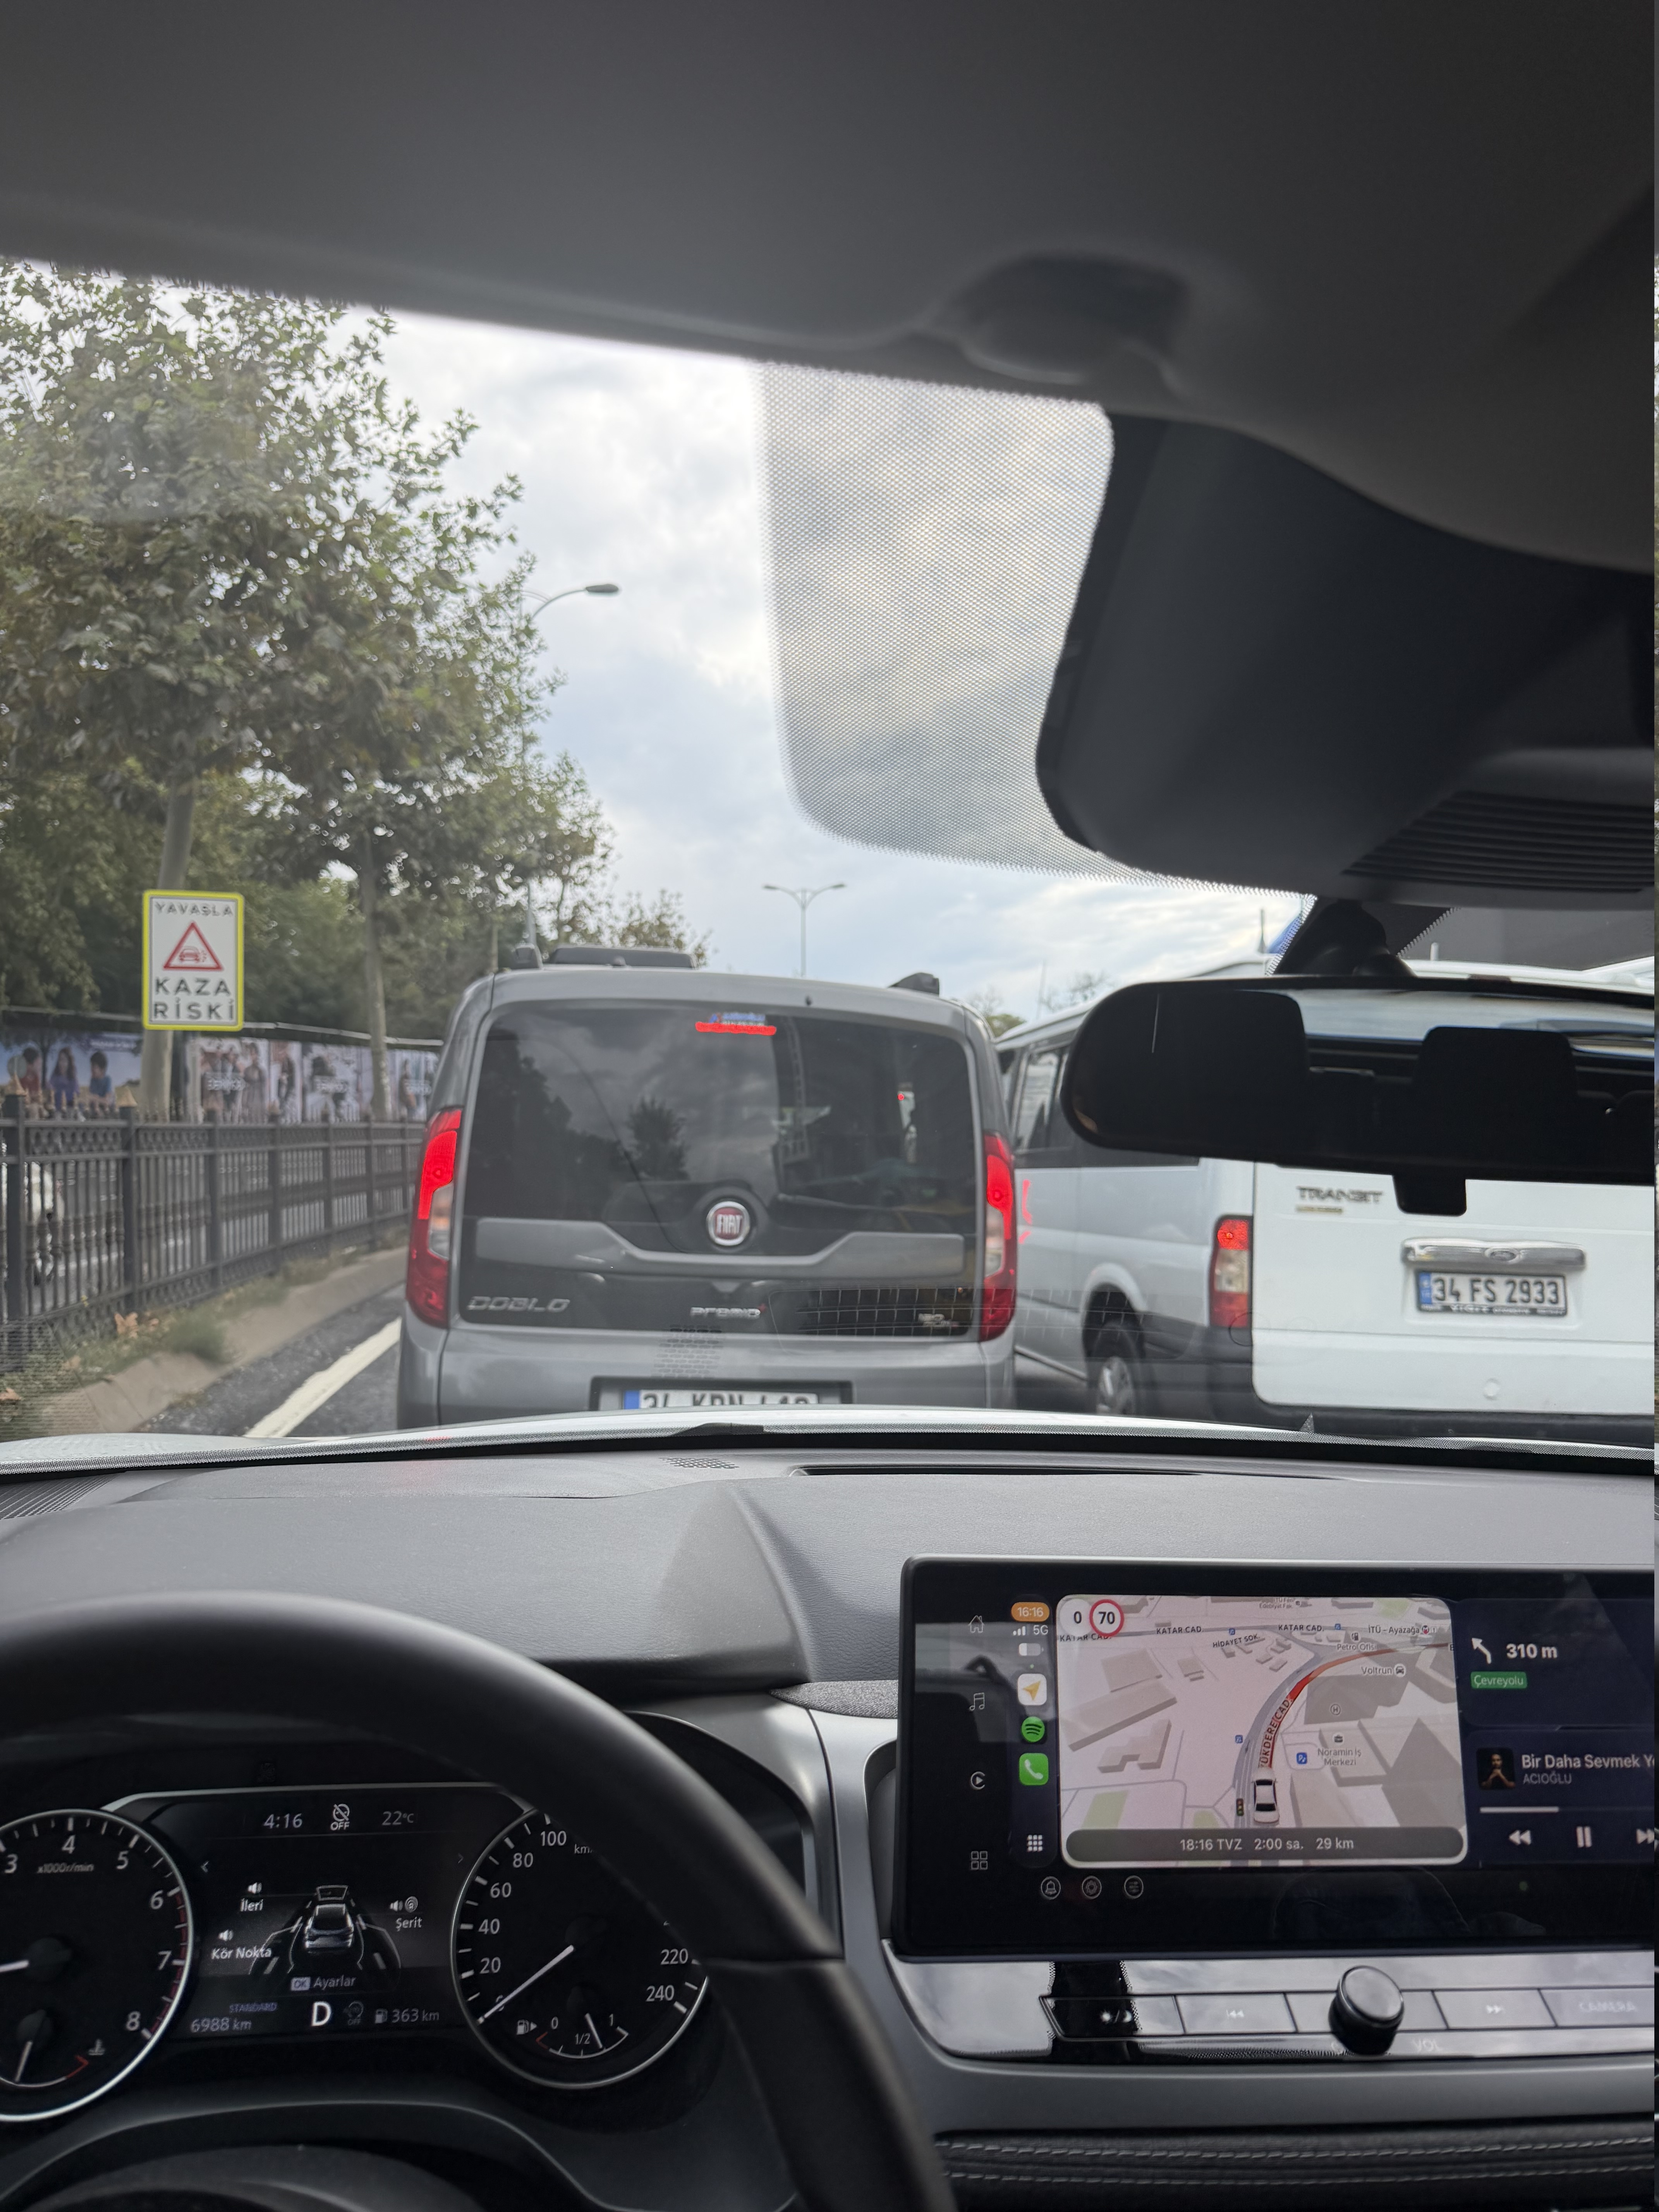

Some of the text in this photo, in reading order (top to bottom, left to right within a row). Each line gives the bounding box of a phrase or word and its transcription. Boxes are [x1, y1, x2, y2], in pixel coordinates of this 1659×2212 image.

[155, 977, 231, 995] KAZA
[155, 997, 234, 1020] RİSKİ
[716, 1214, 743, 1234] FIAT
[1434, 1278, 1558, 1304] 34 FS 2933
[467, 1296, 570, 1312] DOBLO
[1018, 1607, 1043, 1617] 16:16
[1073, 1611, 1082, 1624] 0
[1098, 1611, 1115, 1624] 70
[1033, 1625, 1048, 1635] 5G
[1369, 1625, 1381, 1633] İTÜ
[1389, 1626, 1419, 1635] Ayazağa
[1213, 1633, 1260, 1647] HİDAYET SOK.
[1506, 1644, 1558, 1659] 310 m
[1474, 1675, 1524, 1688] Çevreyolu
[1318, 1748, 1353, 1756] Noramin
[1324, 1758, 1356, 1766] Merkezi
[1522, 1754, 1541, 1769] Bir
[1545, 1754, 1581, 1769] Daha
[1584, 1754, 1640, 1769] Sevmek
[263, 1814, 302, 1829] 4:16
[331, 1822, 349, 1830] OFF
[382, 1811, 414, 1826] 22°C
[62, 1835, 75, 1853] 4
[541, 1831, 567, 1846] 100
[1180, 1837, 1354, 1851] 18:16 TVZ 2:00 sa. 29 km
[5, 1854, 18, 1873] 3
[117, 1851, 129, 1869] 5
[513, 1852, 533, 1868] 80
[490, 1882, 512, 1898] 60
[150, 1890, 163, 1910] 6
[396, 1917, 422, 1931] Şerit
[479, 1918, 500, 1934] 40
[158, 1951, 172, 1970] 7
[211, 1946, 271, 1960] Kör Nokta
[661, 1948, 688, 1965] 220
[480, 1957, 501, 1973] 20
[314, 1975, 356, 1990] Ayarlar
[646, 1985, 675, 2002] 240
[125, 2011, 141, 2031] 8
[311, 2001, 332, 2026] D
[392, 2008, 440, 2023] 363 km
[609, 2014, 614, 2026] 1
[191, 2017, 252, 2033] 6988 km
[550, 2017, 558, 2029] 0
[575, 2033, 591, 2045] 1/2
[1413, 2039, 1441, 2052] VOL
